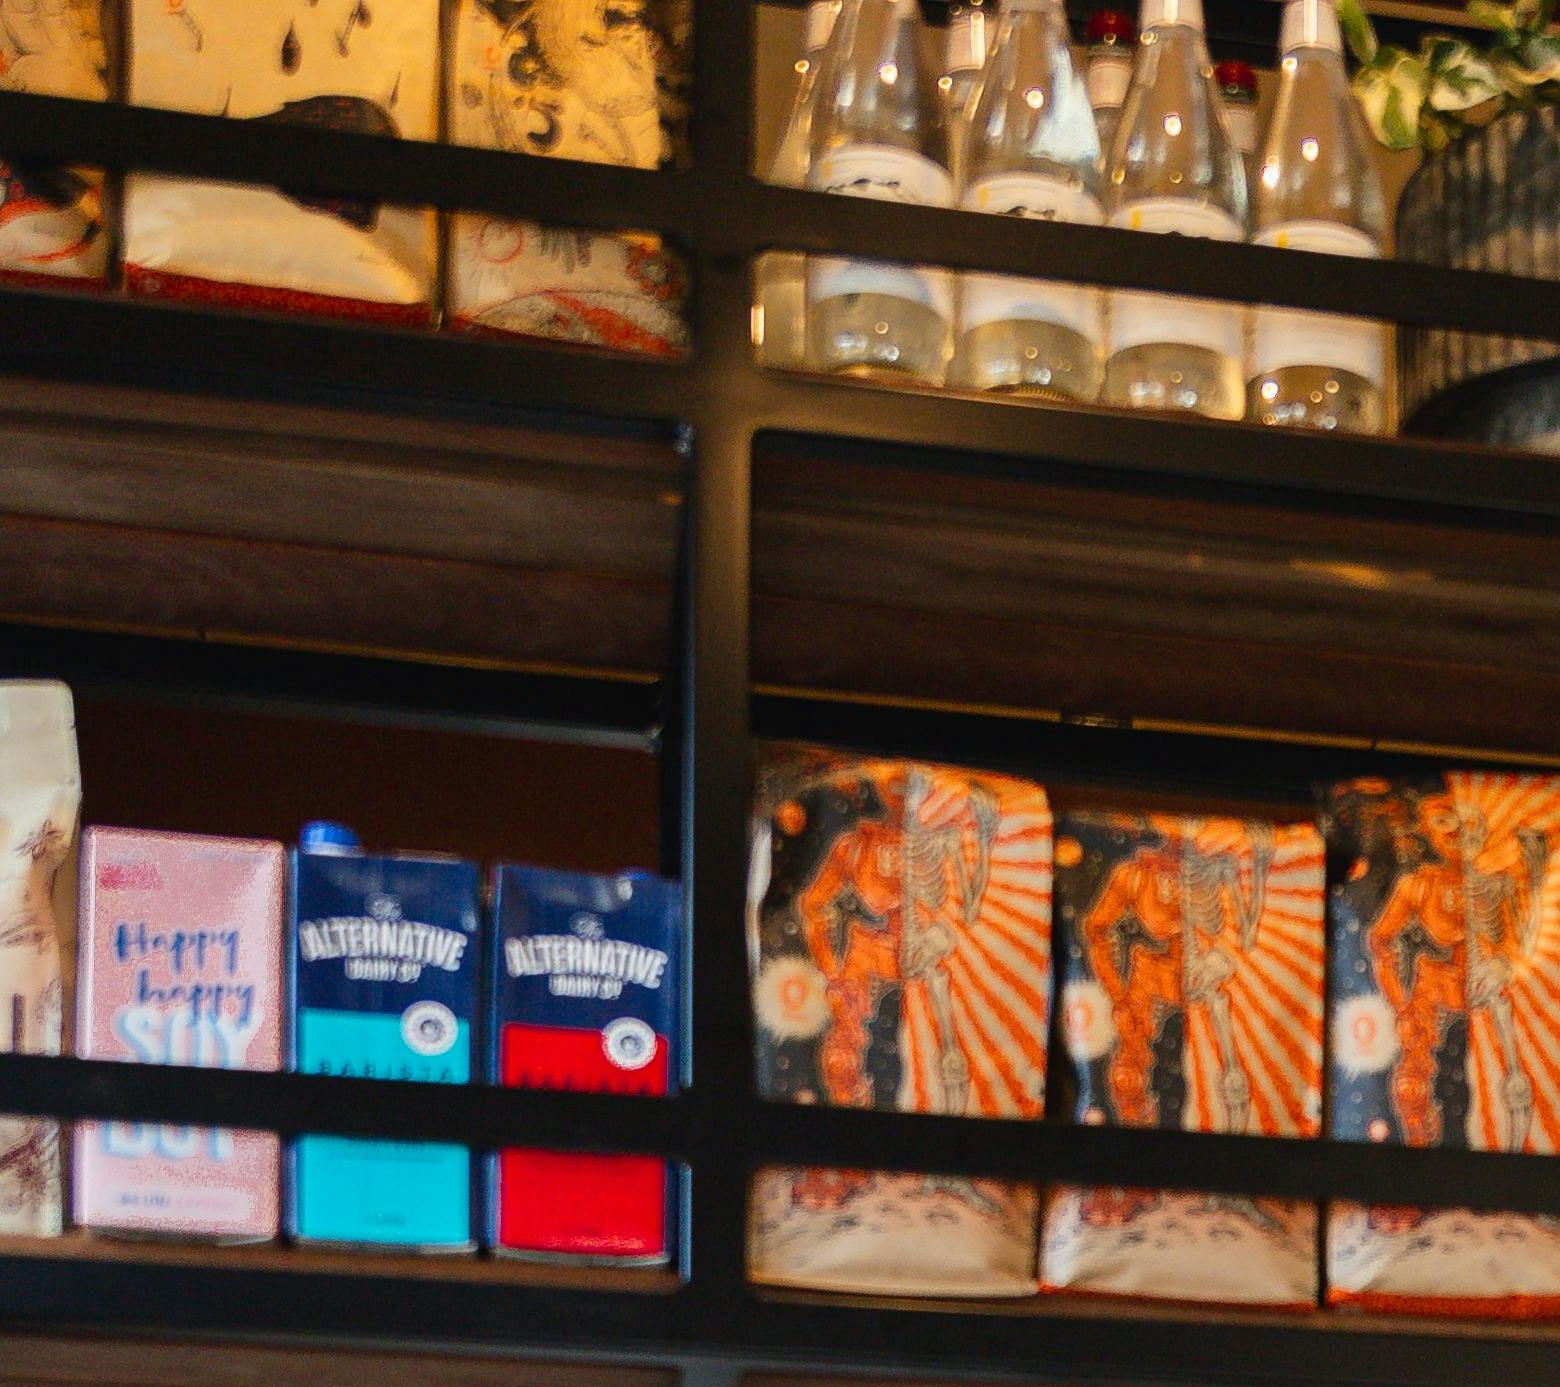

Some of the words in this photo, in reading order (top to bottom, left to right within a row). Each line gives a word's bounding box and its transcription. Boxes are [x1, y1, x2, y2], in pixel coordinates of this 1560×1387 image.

[114, 920, 239, 975] Happy
[299, 915, 468, 972] ALTERNATIVE
[504, 934, 668, 990] ALTERNATIVE
[137, 967, 255, 1032] happy
